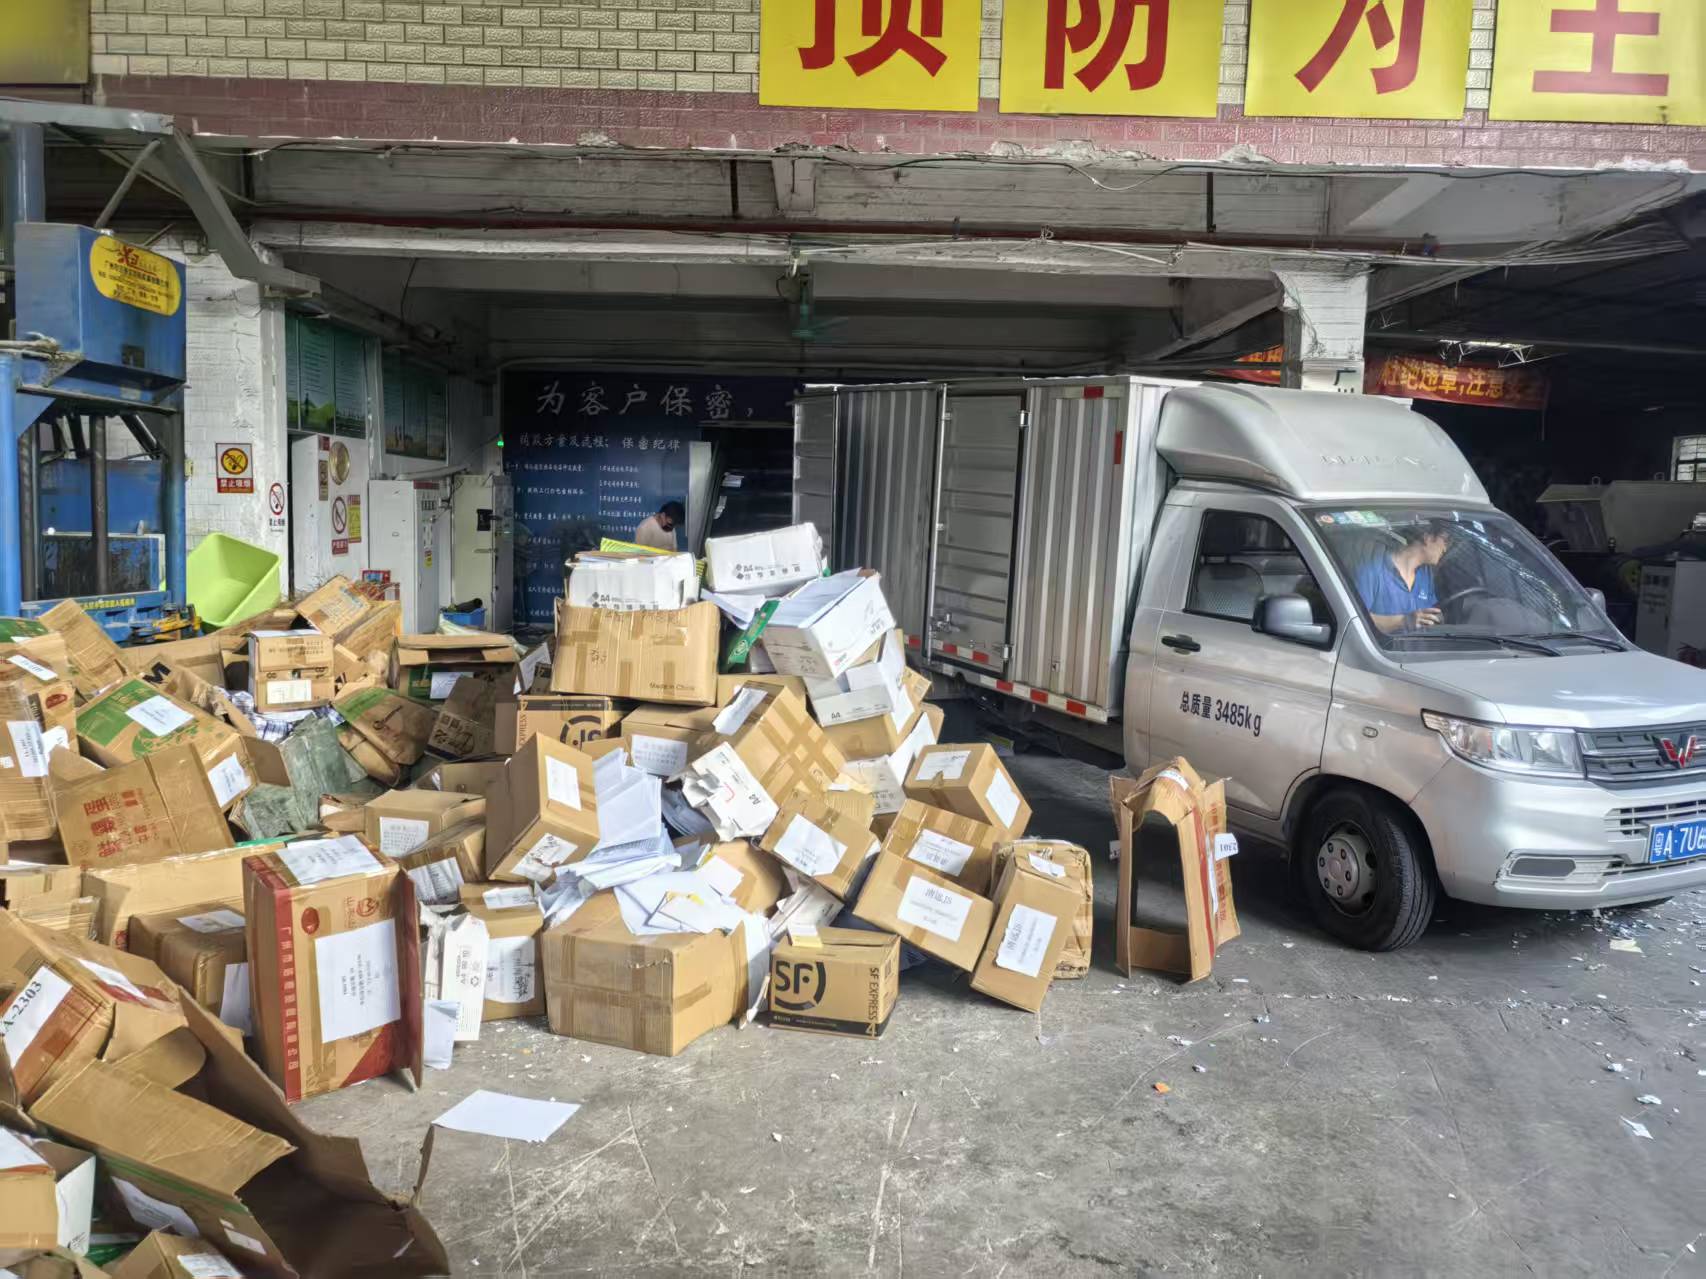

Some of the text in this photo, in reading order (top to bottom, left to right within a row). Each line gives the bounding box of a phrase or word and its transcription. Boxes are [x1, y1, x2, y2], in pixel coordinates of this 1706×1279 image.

[600, 594, 610, 602] A4
[1180, 690, 1262, 738] 总质量 3485kg
[775, 960, 813, 994] SF
[867, 967, 880, 1021] SF EXPRESS
[865, 1022, 878, 1039] 4
